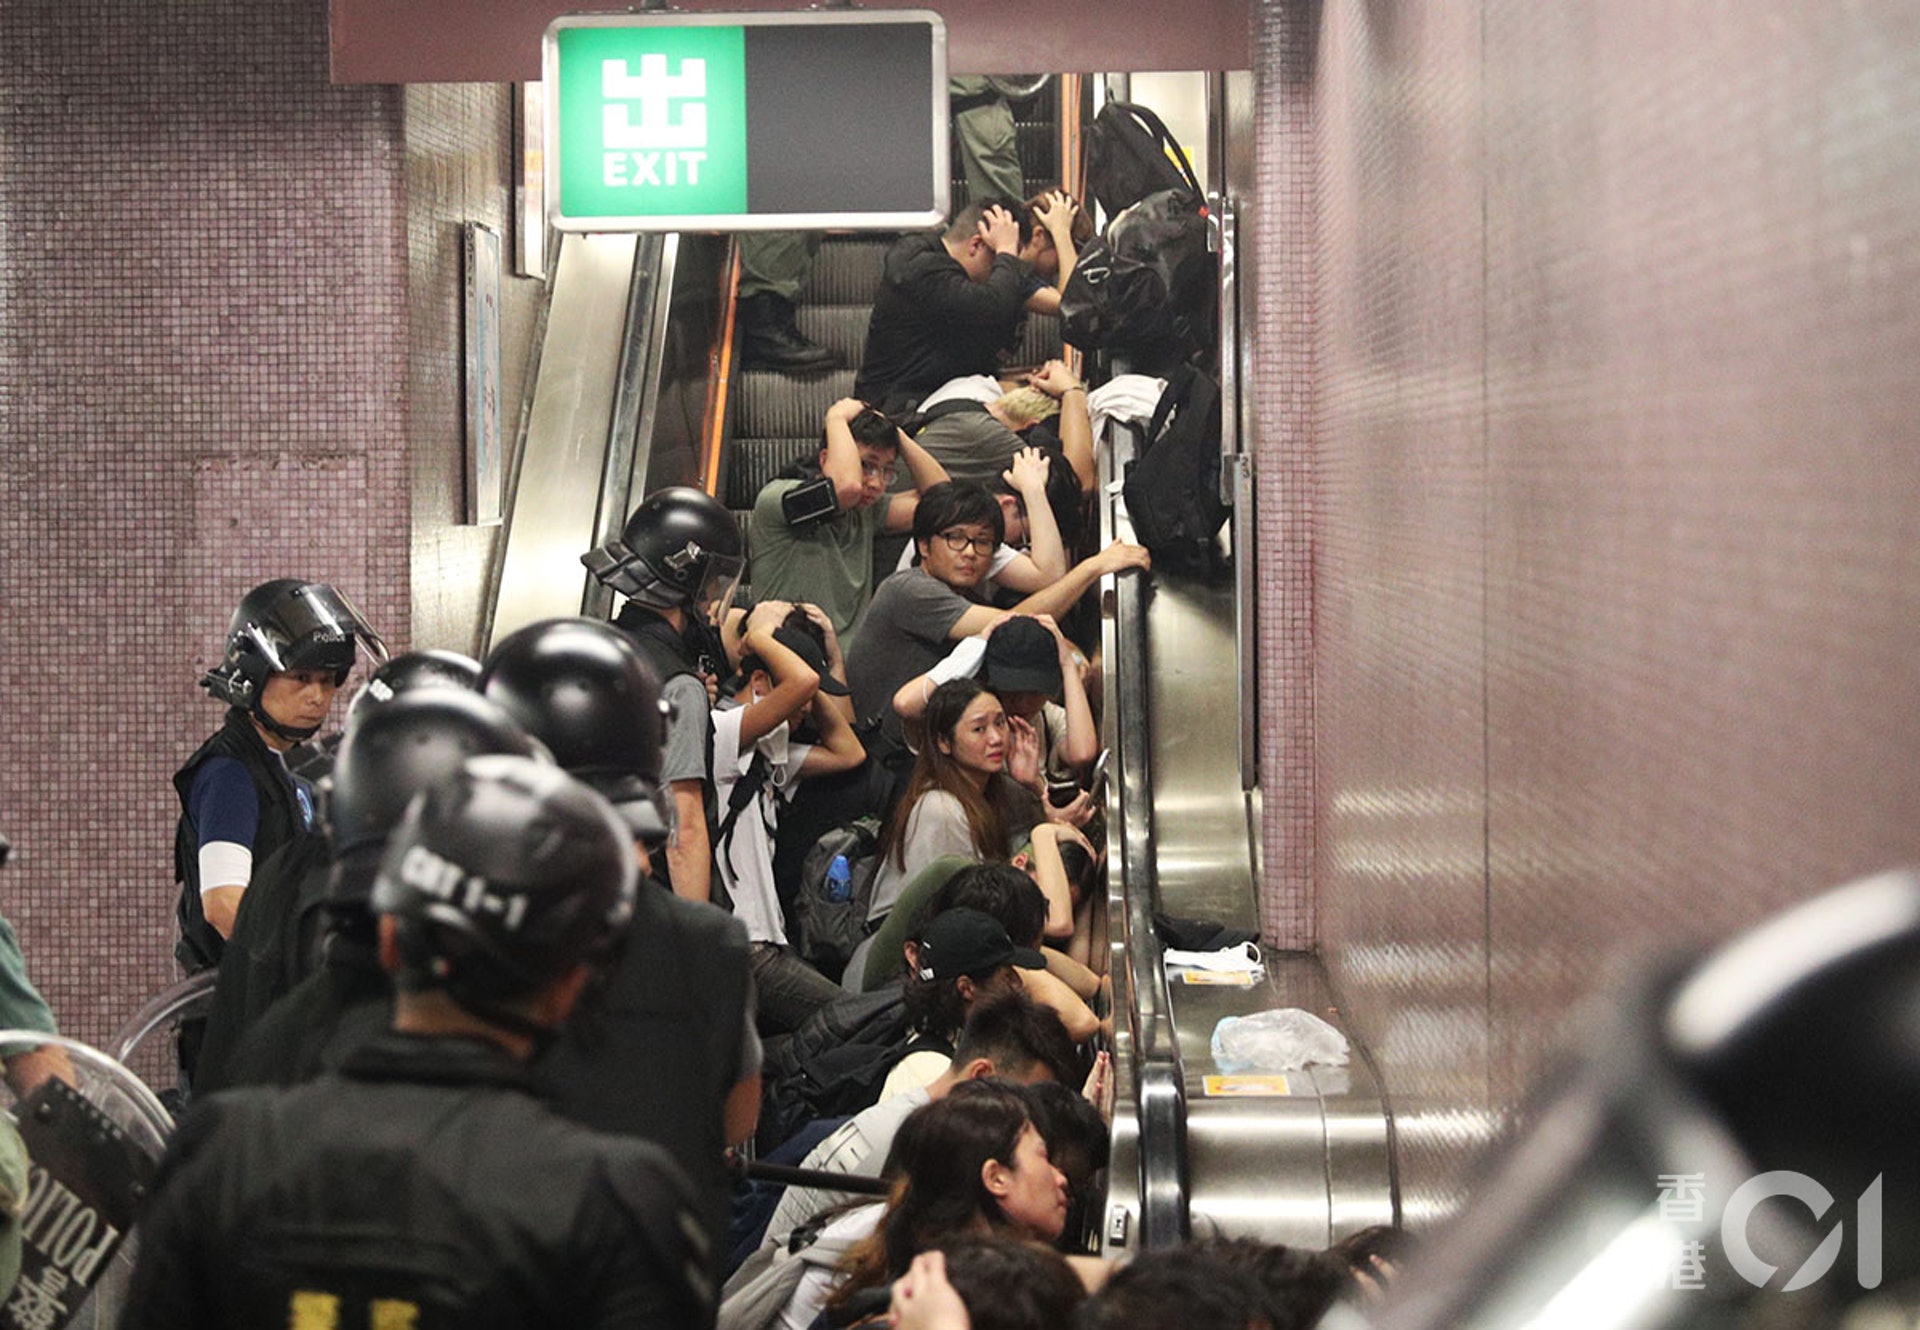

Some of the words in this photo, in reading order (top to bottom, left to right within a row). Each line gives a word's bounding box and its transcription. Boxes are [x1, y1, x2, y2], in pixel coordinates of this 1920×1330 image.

[602, 53, 707, 148] 出
[603, 151, 707, 187] EXIT
[23, 1166, 118, 1287] POLIC
